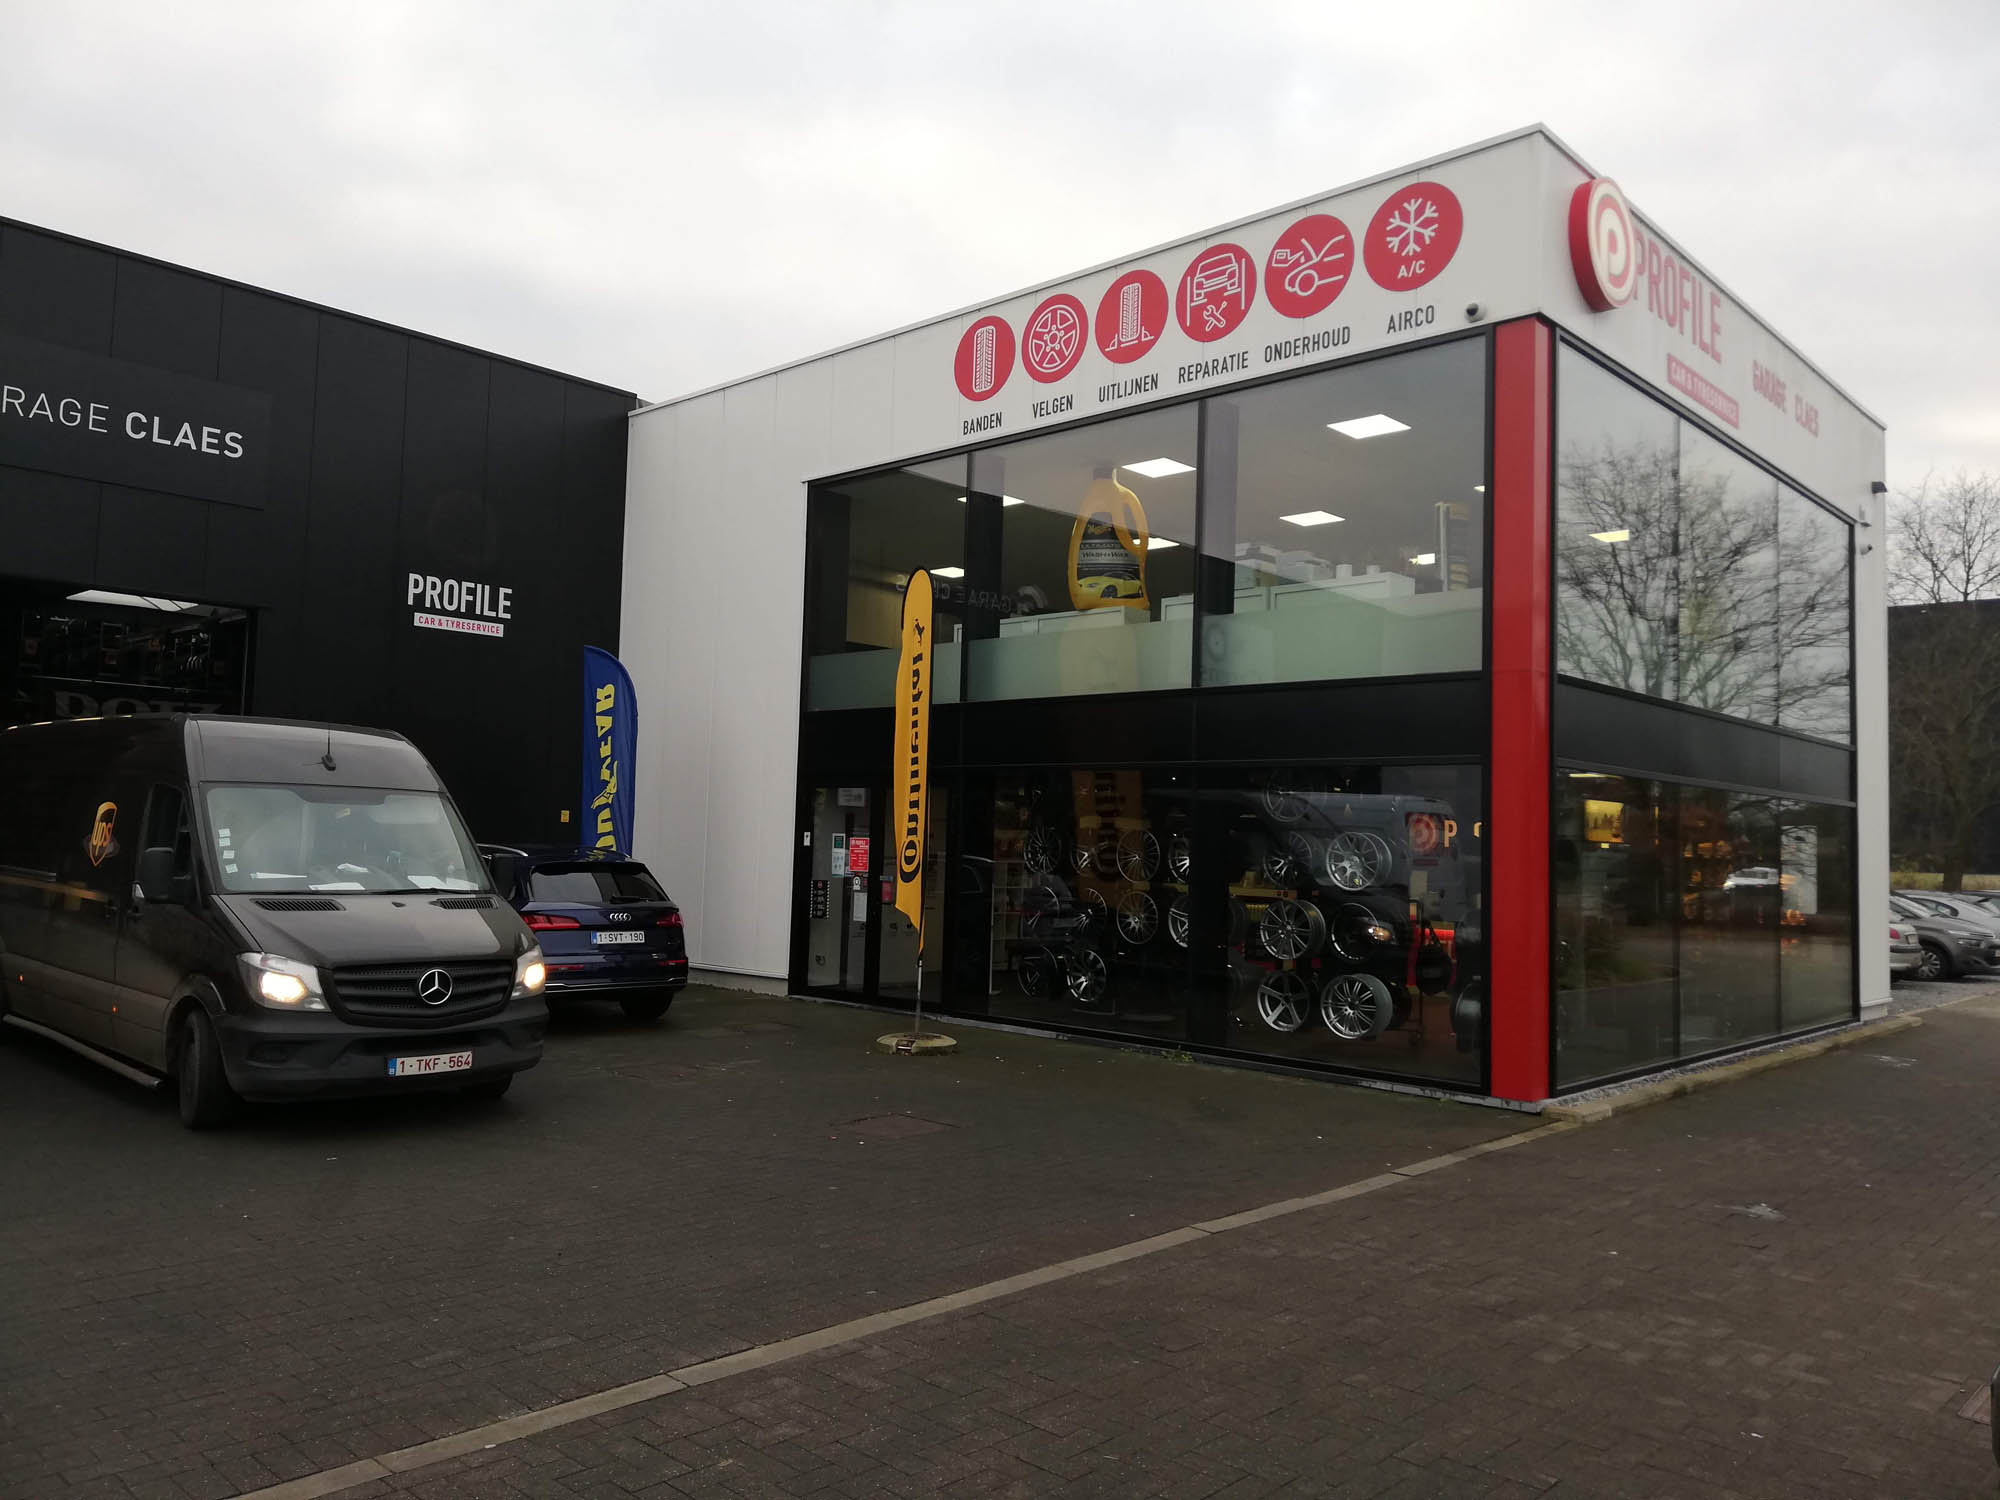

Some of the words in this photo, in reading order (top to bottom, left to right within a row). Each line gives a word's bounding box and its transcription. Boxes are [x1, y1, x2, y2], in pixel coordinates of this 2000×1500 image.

[1397, 260, 1426, 280] A/C
[1633, 226, 1722, 365] PROFILE
[1386, 305, 1435, 334] AIRCO
[1264, 326, 1351, 363] ONDERHOUD
[1178, 350, 1249, 384] REPARATIE
[1098, 373, 1159, 403] UITLIJNEN
[1032, 394, 1074, 419] VELGEN
[125, 411, 244, 459] CLAES
[963, 411, 1003, 436] BANDEN
[407, 572, 513, 620] PROFILE
[418, 615, 436, 627] CAR
[437, 619, 444, 628] &
[445, 619, 501, 636] TYRESERVICE
